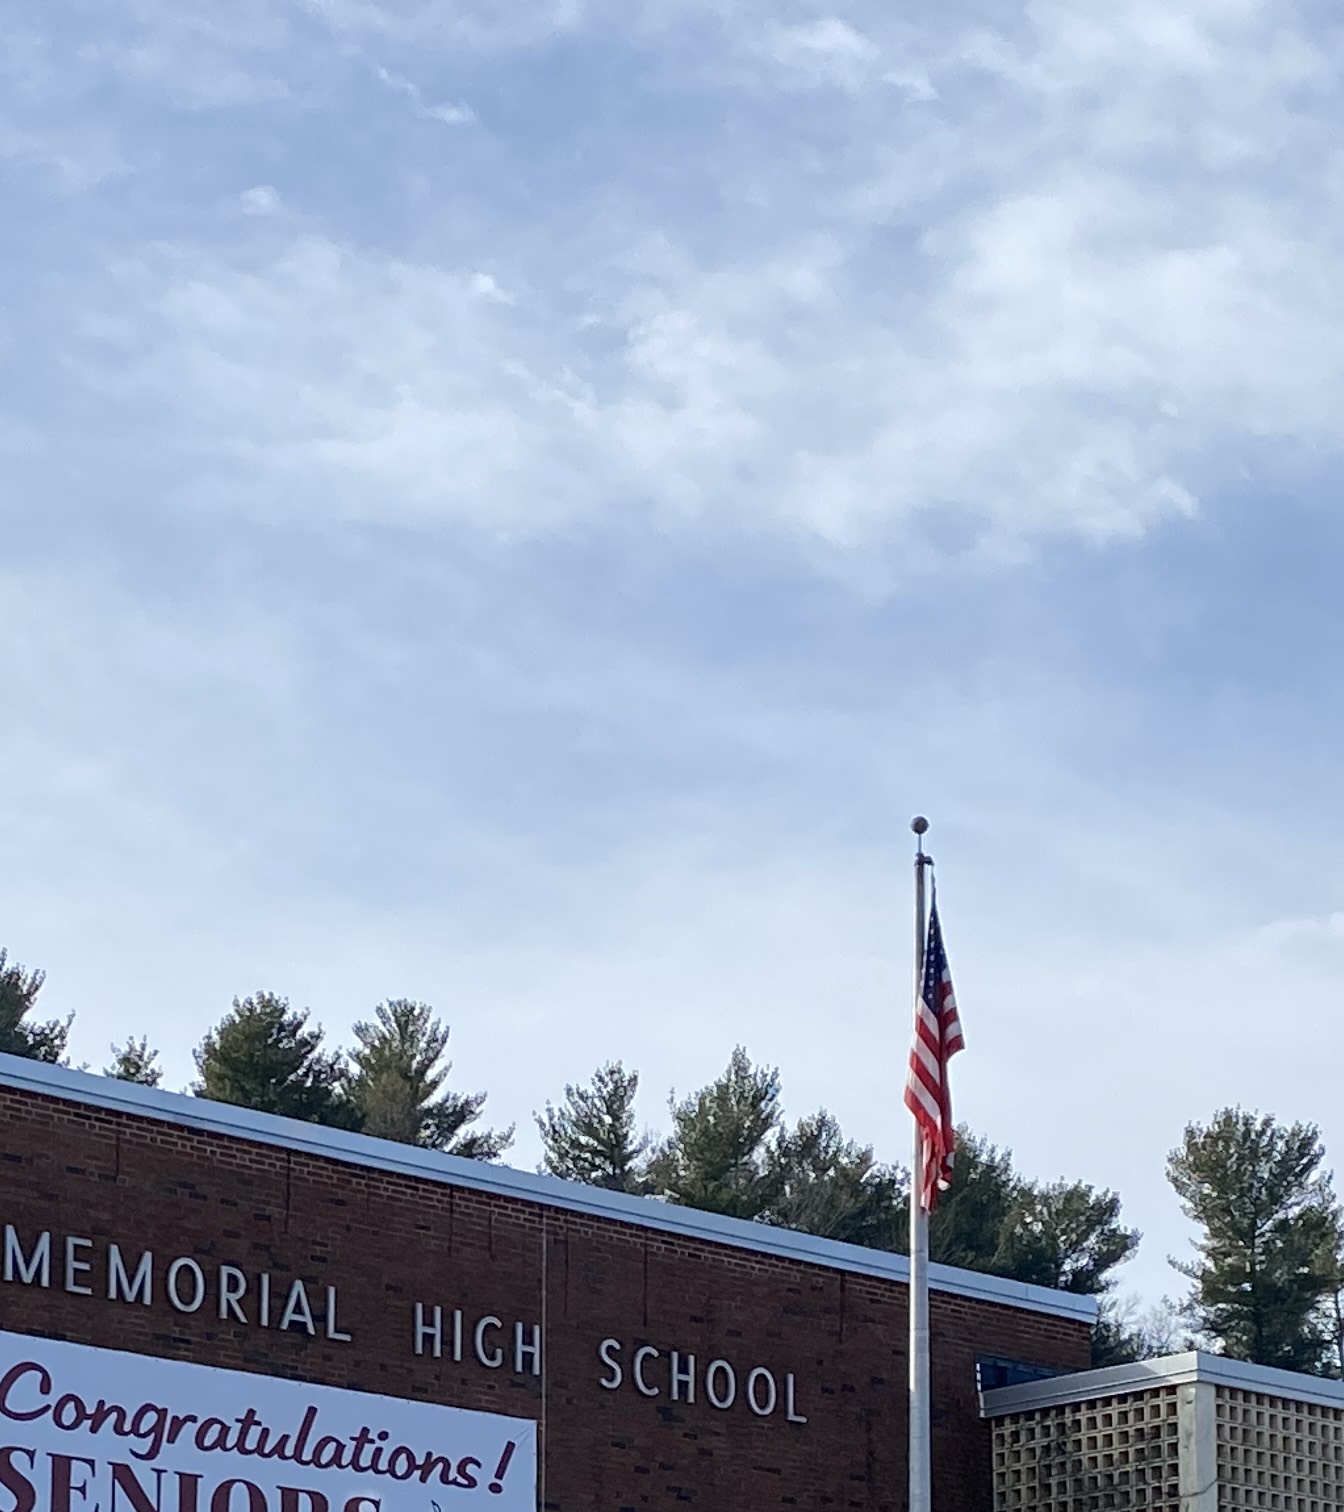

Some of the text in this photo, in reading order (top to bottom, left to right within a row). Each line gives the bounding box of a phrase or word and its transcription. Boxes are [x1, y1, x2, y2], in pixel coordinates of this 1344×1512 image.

[3, 1223, 352, 1342] MEMORIAL
[413, 1302, 541, 1376] HIGH
[597, 1338, 808, 1424] SCHOOL
